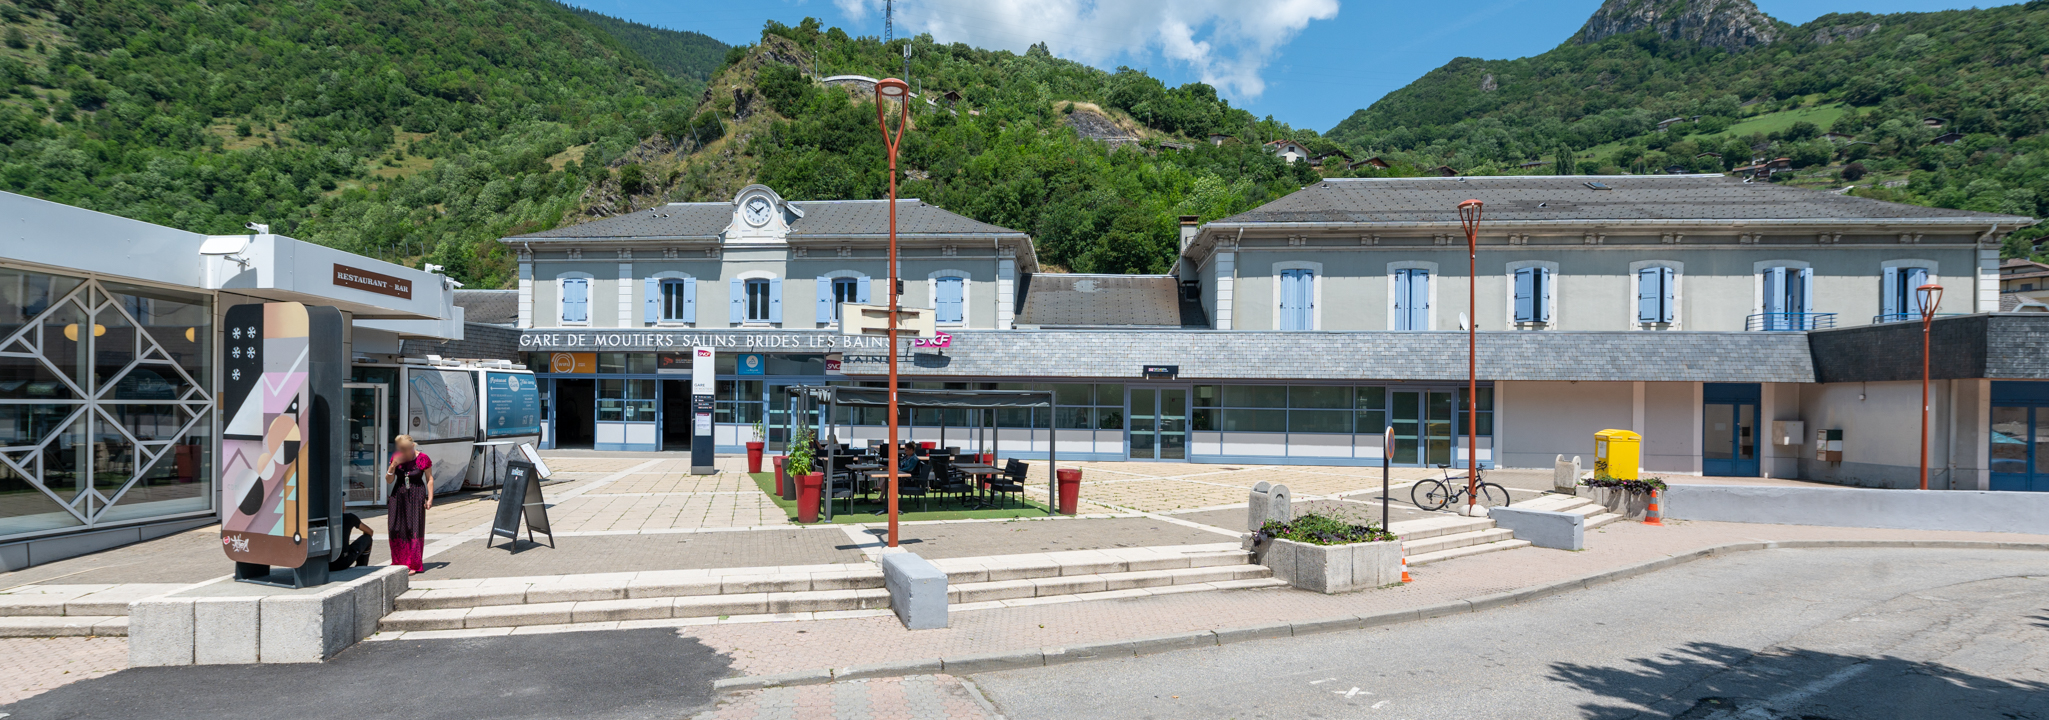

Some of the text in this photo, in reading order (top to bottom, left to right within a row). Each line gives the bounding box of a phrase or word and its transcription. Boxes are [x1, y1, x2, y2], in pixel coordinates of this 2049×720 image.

[337, 271, 387, 288] RESTAURANT
[394, 283, 409, 293] BAR
[519, 334, 560, 347] GARE
[567, 334, 586, 346] DE
[594, 334, 674, 347] MOUTIERS
[682, 334, 736, 347] SALINS
[746, 335, 800, 348] BRIDES
[809, 335, 836, 348] LES
[916, 335, 950, 346] SNCF
[826, 363, 841, 371] SNC
